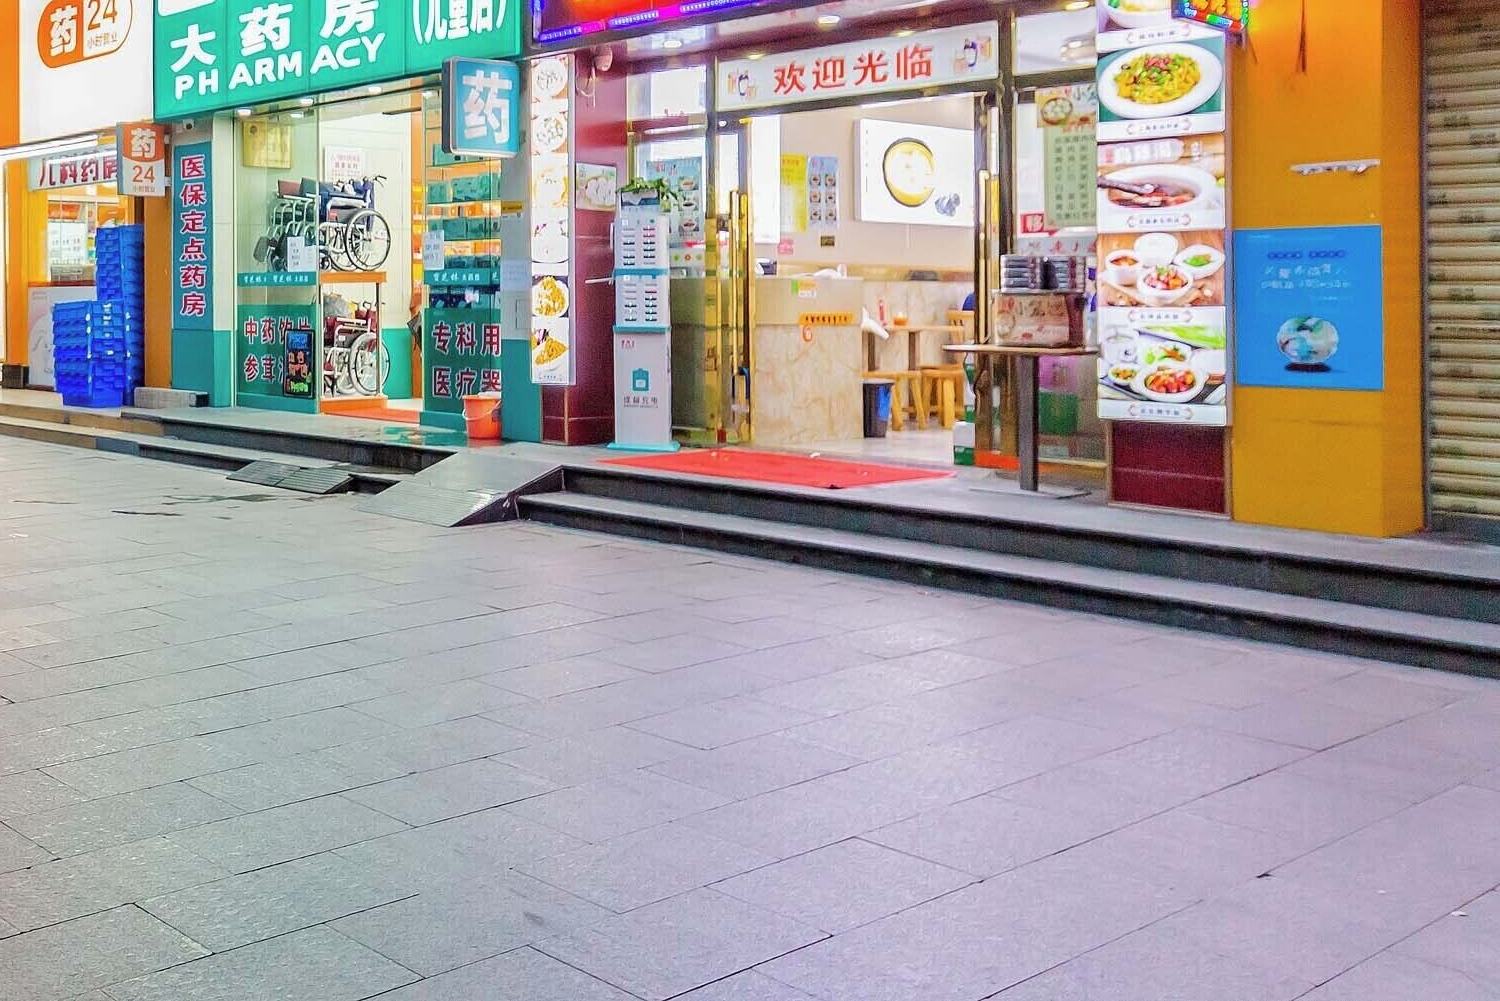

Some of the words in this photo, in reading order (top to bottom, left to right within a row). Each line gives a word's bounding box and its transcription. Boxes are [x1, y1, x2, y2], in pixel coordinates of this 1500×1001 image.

[50, 4, 78, 57] 药
[773, 42, 933, 95] 欢迎光临
[462, 70, 513, 145] 药
[130, 127, 157, 159] 药
[132, 165, 156, 183] 24
[180, 154, 207, 317] 医保定点药房
